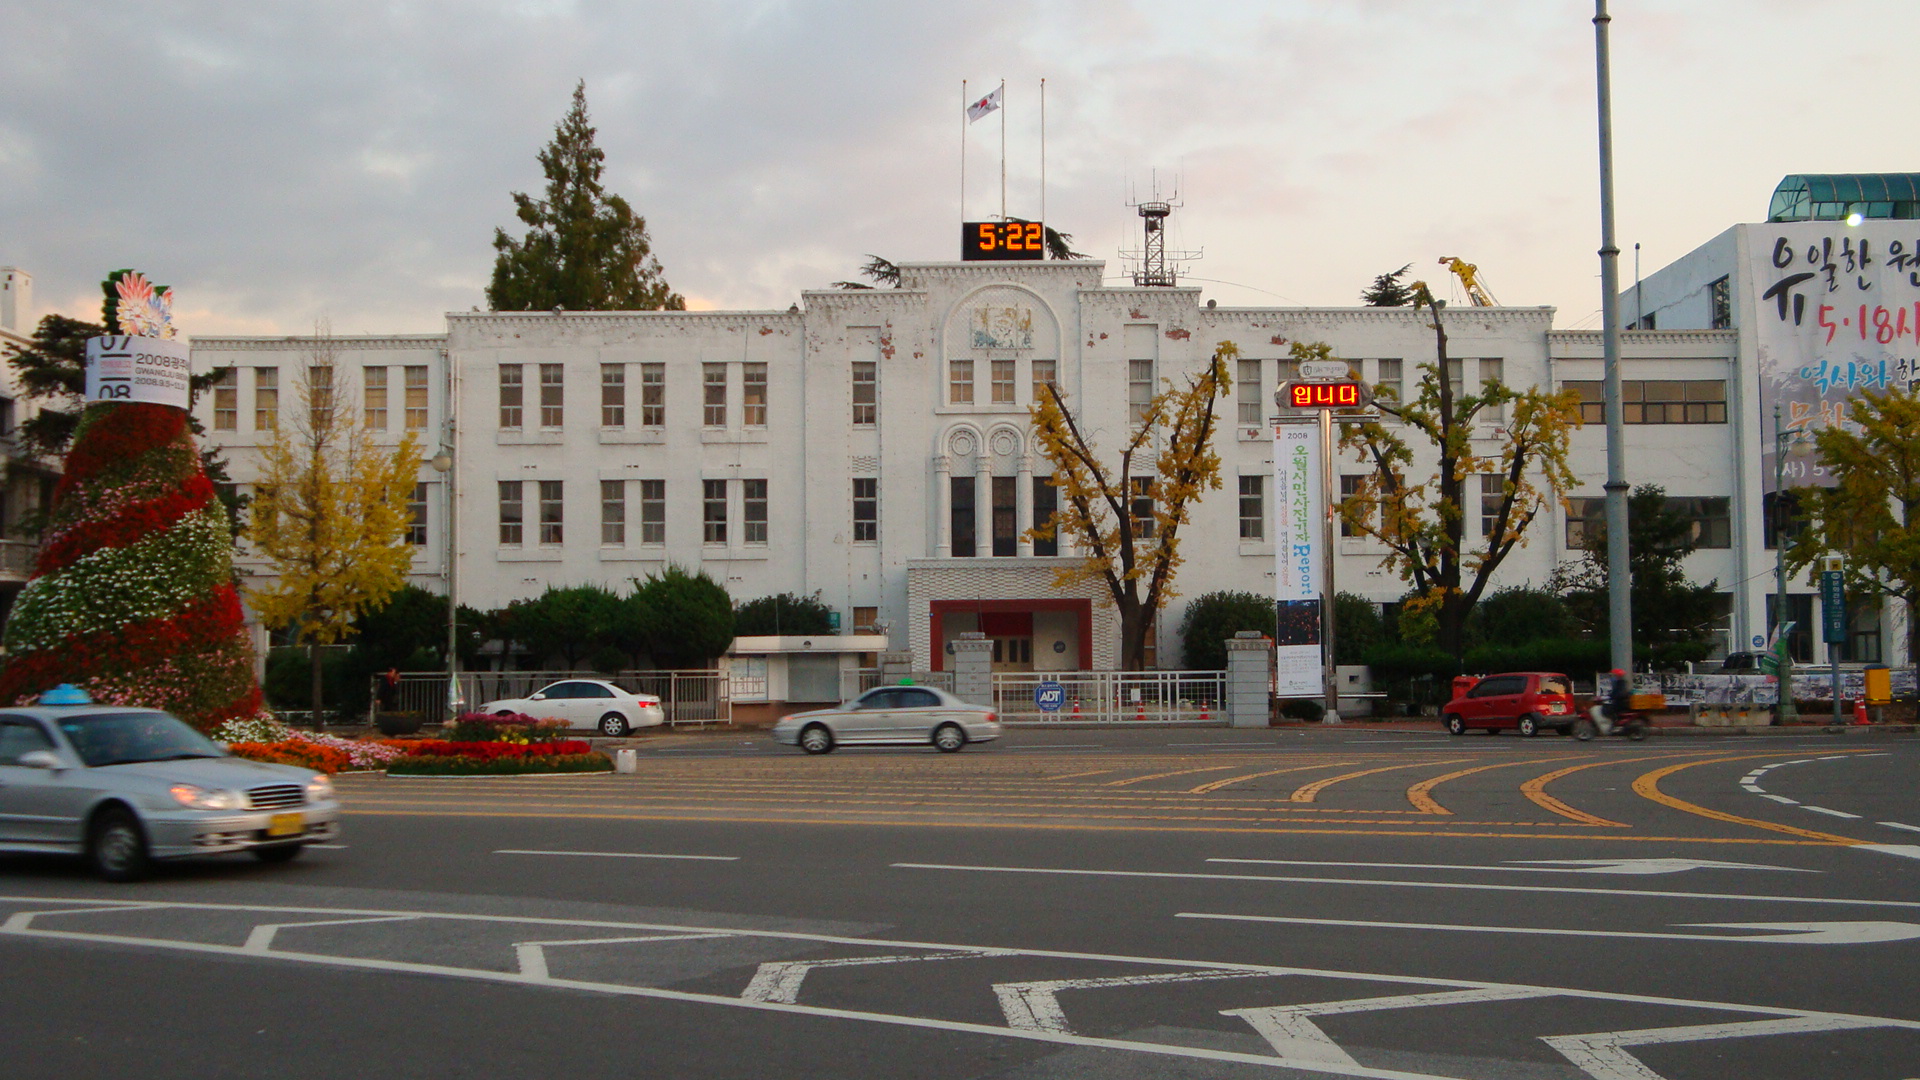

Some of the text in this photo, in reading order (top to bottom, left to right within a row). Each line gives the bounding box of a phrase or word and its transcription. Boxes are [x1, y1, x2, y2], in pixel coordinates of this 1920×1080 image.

[979, 223, 1042, 250] 5:22
[1762, 236, 1872, 326] 유일한
[1800, 360, 1892, 395] 역사와
[99, 384, 131, 399] 08
[1294, 386, 1358, 404] 입니다
[1287, 432, 1308, 440] 2008
[1293, 544, 1313, 595] Report
[1040, 690, 1061, 702] ADT
